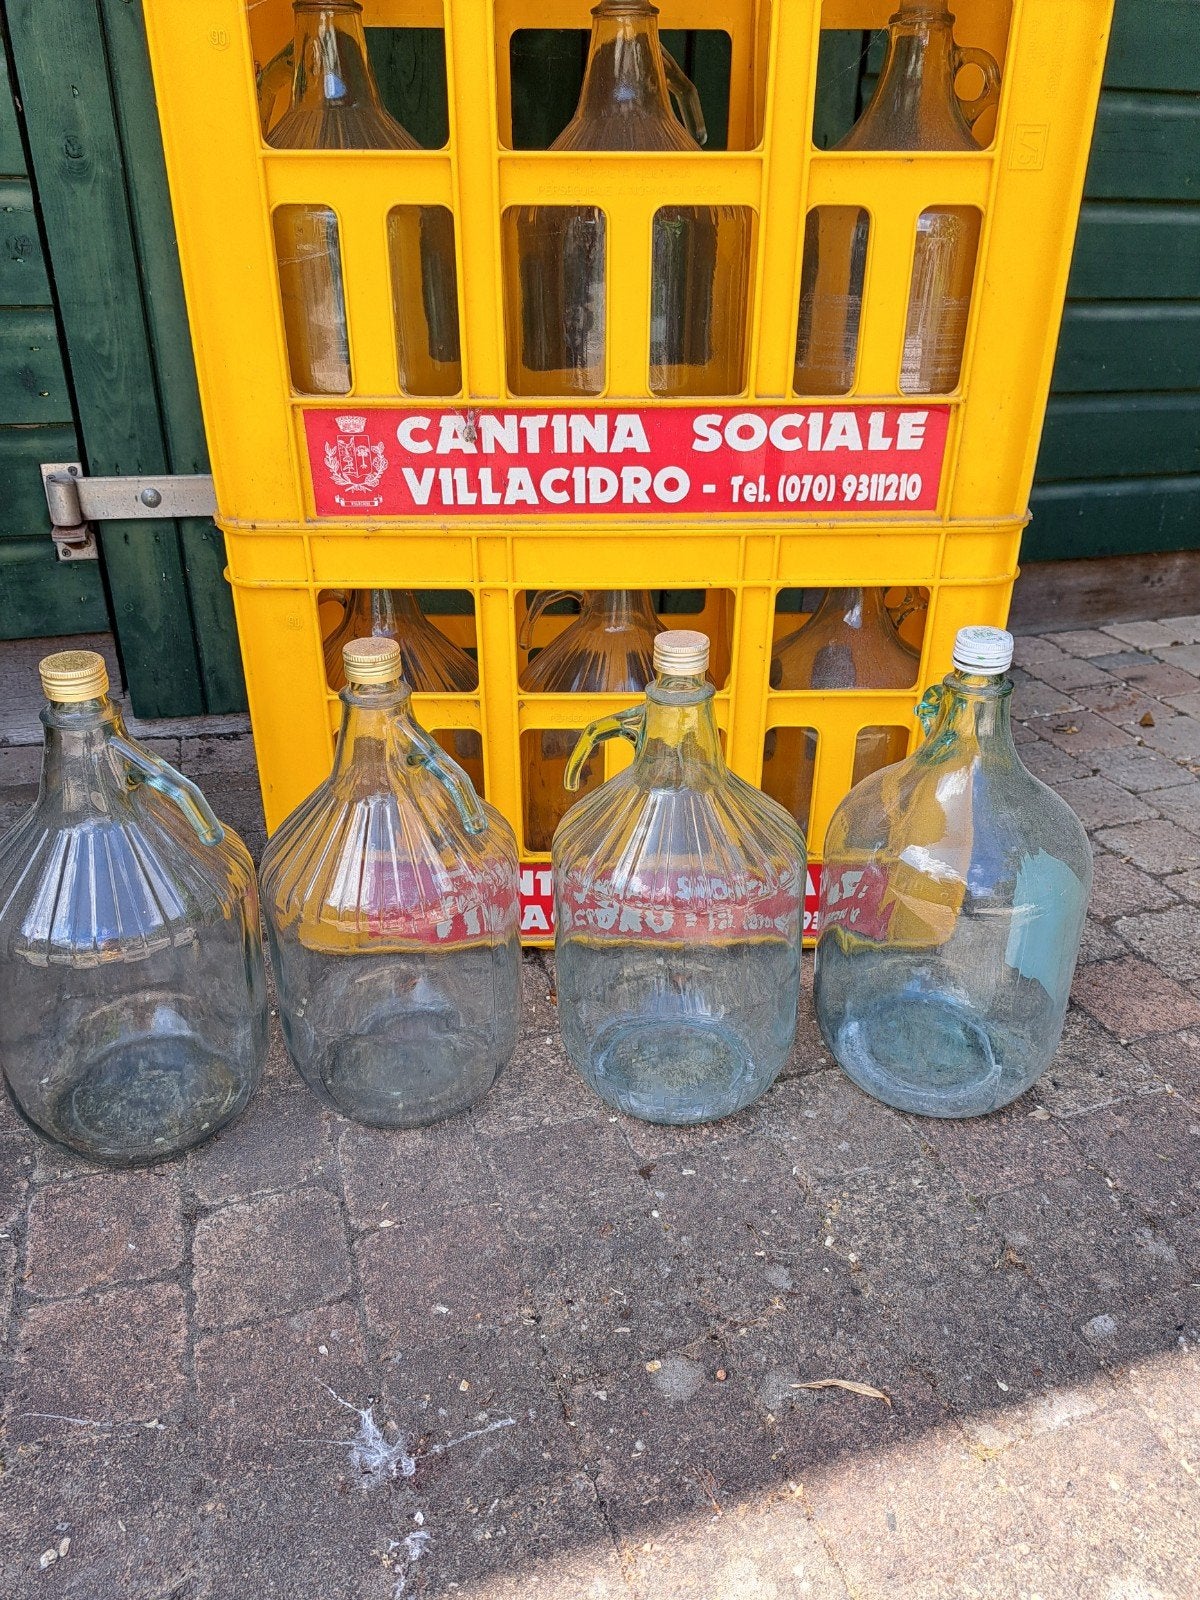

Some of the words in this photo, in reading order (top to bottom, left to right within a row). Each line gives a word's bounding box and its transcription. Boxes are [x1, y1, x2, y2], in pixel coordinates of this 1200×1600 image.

[210, 29, 227, 46] 90
[396, 413, 651, 455] CANTINA
[691, 410, 930, 453] SOCIALE
[401, 465, 691, 506] VILLACIDRO
[702, 484, 716, 494] -
[730, 474, 772, 504] Tel.
[777, 474, 836, 504] (070)
[841, 473, 923, 503] 9311210
